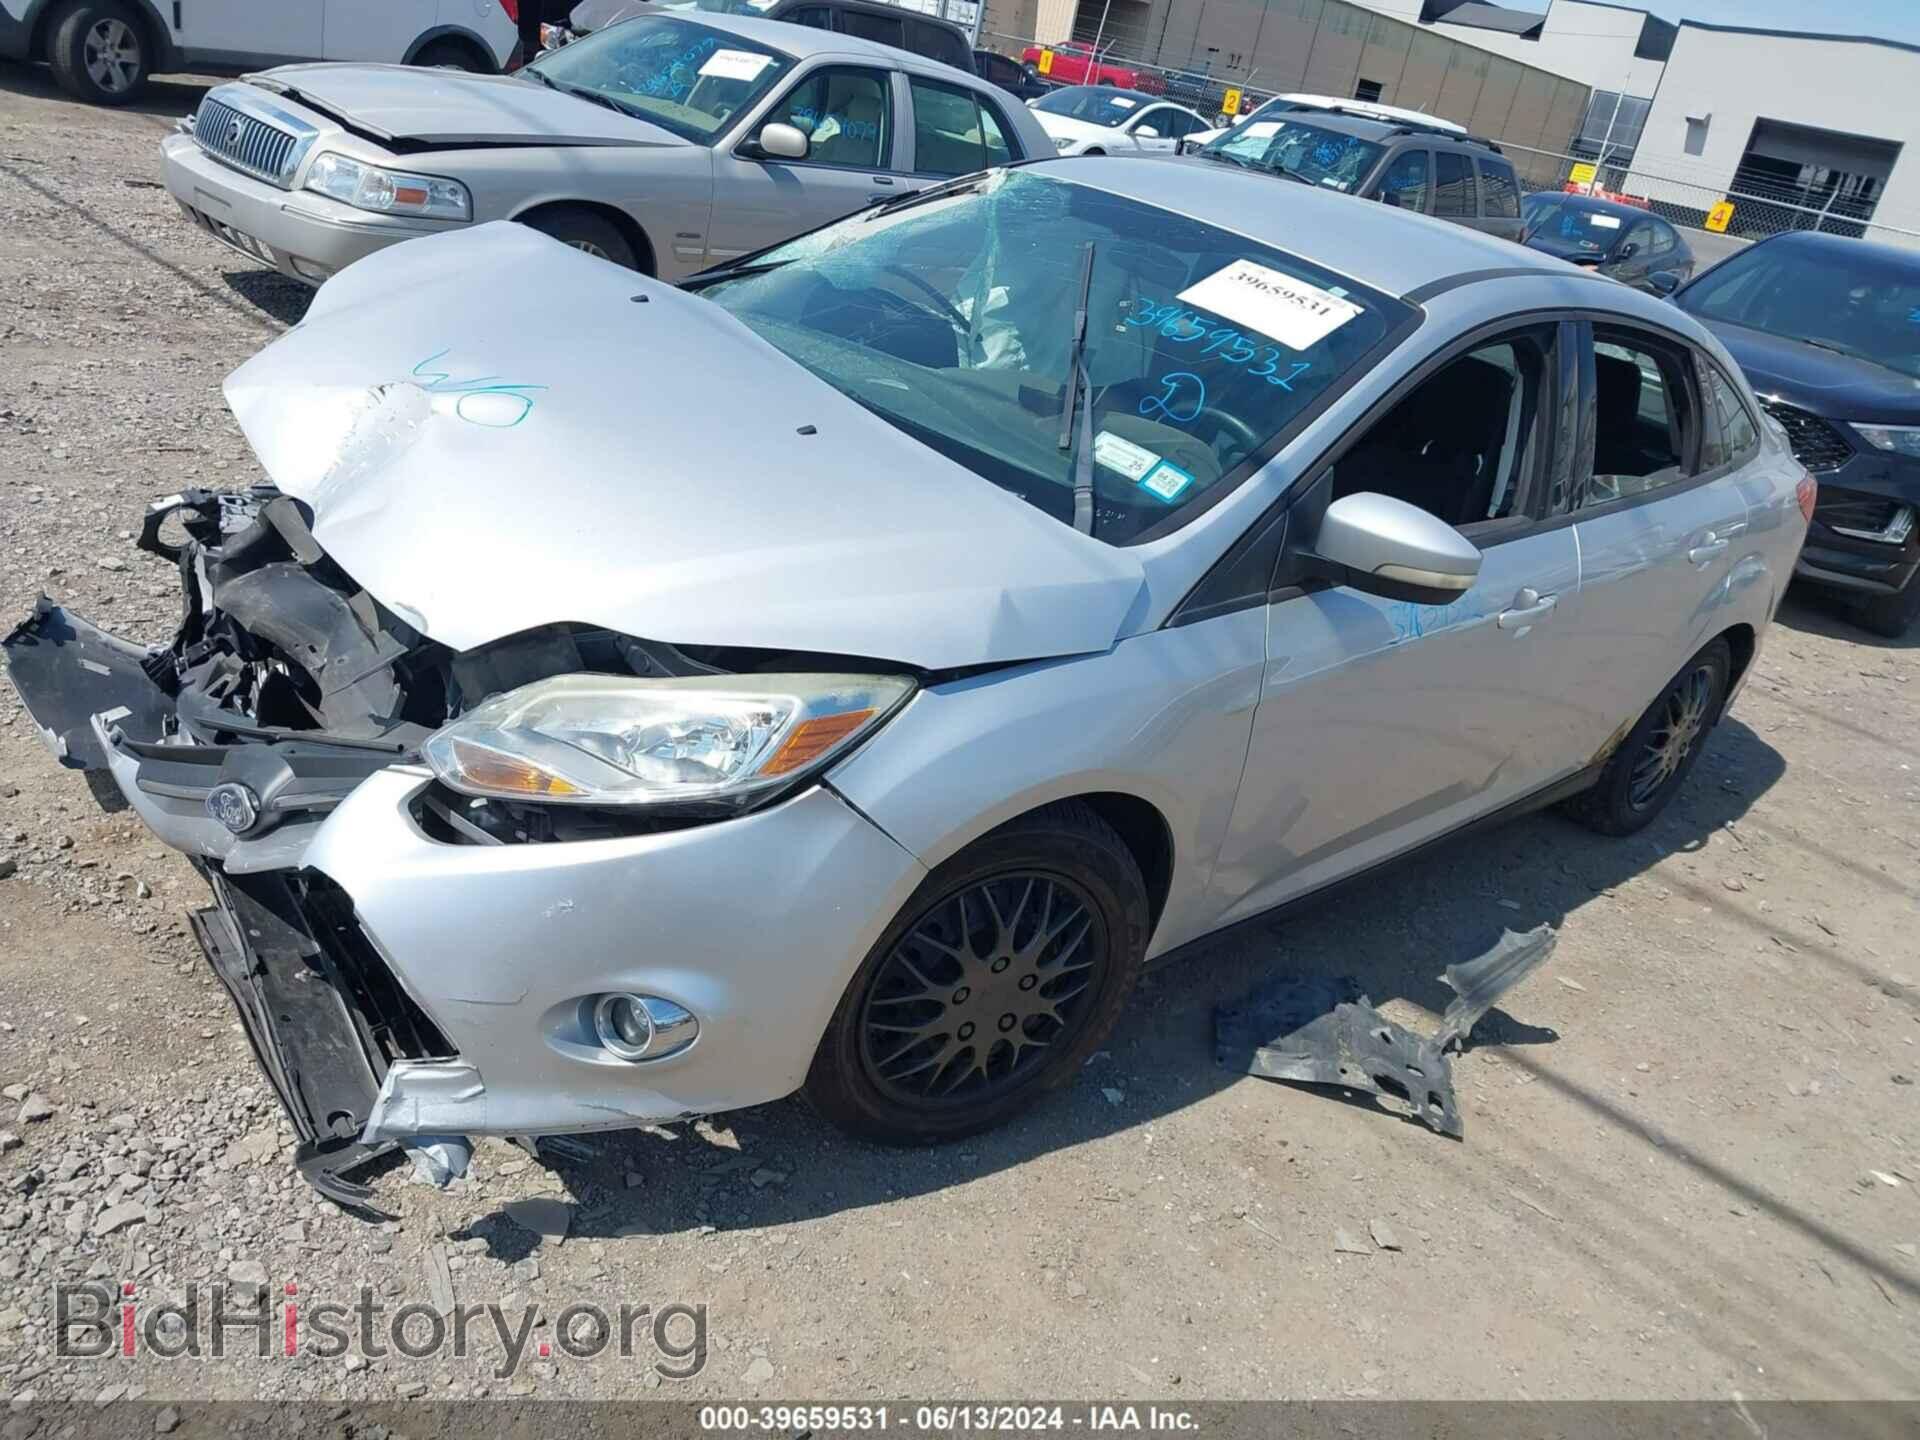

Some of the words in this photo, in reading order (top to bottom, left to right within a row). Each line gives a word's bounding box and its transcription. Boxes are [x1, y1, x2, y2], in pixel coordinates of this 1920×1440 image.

[1226, 95, 1237, 109] 2
[1712, 208, 1726, 224] 4
[1229, 272, 1331, 316] 39659531
